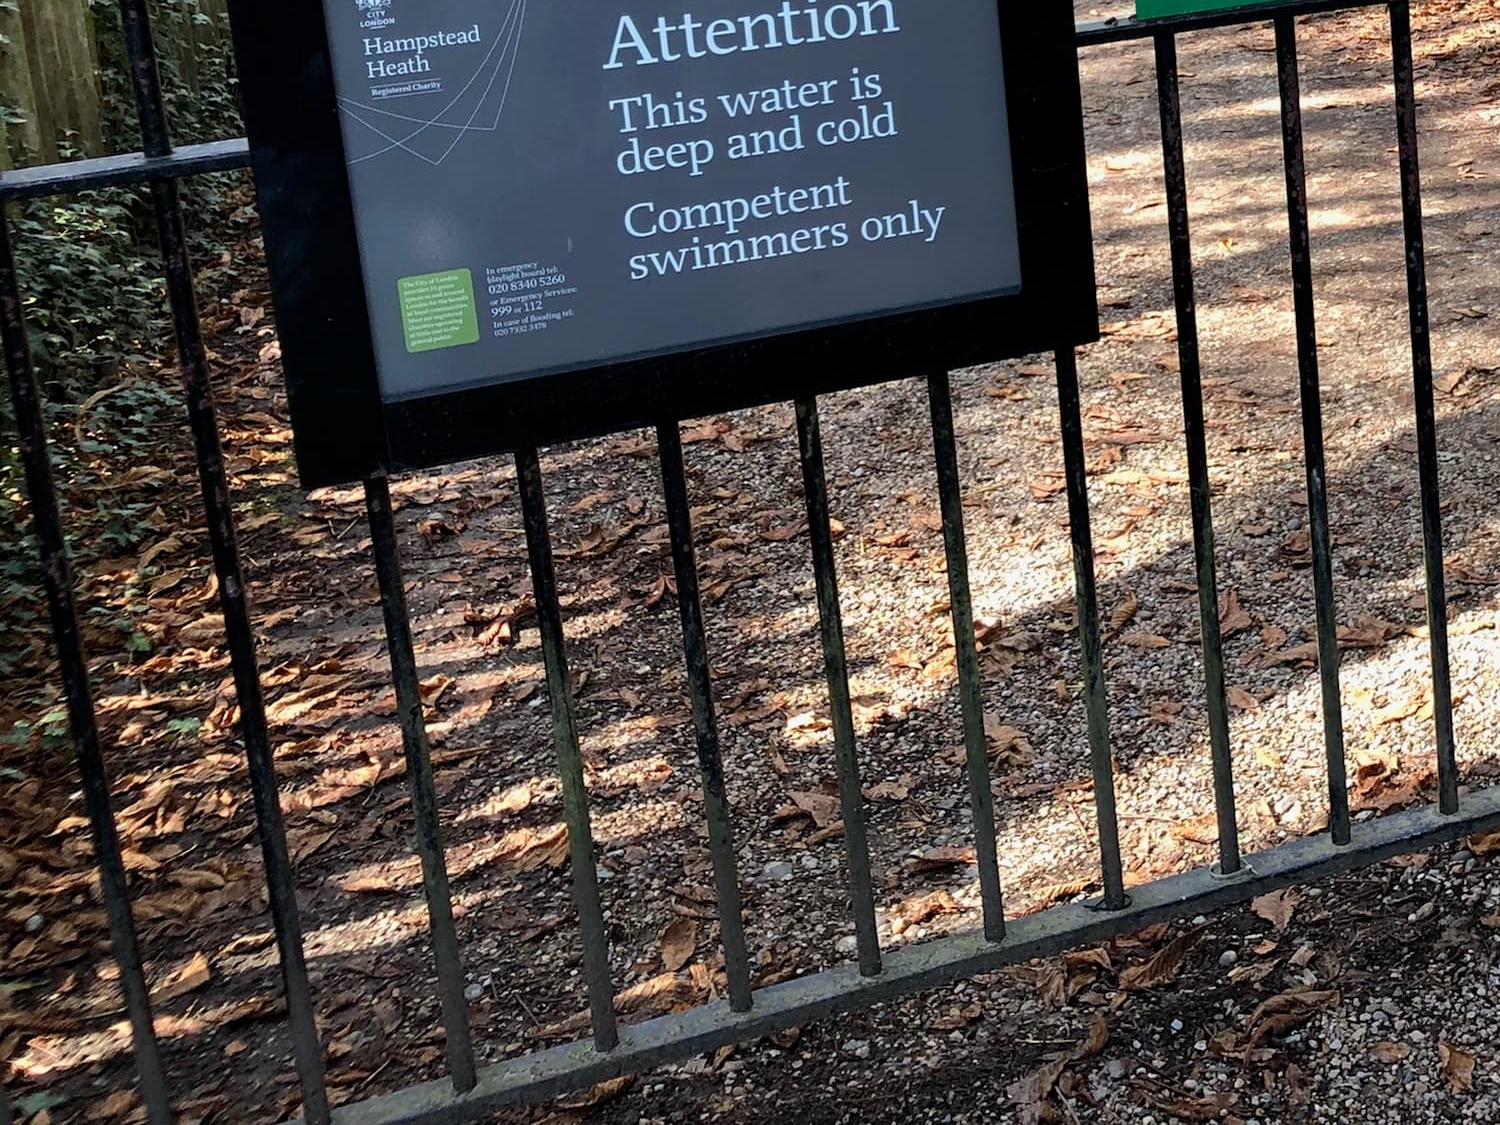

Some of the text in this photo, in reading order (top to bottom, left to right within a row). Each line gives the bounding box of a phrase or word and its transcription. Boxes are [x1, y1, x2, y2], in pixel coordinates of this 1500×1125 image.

[360, 18, 395, 27] LONDON
[367, 10, 385, 18] CITY
[363, 25, 480, 55] Hampstead
[366, 55, 430, 78] Heath
[371, 81, 441, 97] Registered Charity
[609, 67, 882, 134] This water is
[617, 101, 898, 176] deep and cold
[624, 176, 852, 238] Competent
[629, 200, 946, 280] swimmers only
[496, 262, 537, 272] emergency
[488, 274, 565, 294] 020 8340 5260
[500, 293, 542, 304] Emergency
[491, 306, 512, 317] 999
[524, 301, 543, 312] 112
[530, 312, 561, 322] flooding
